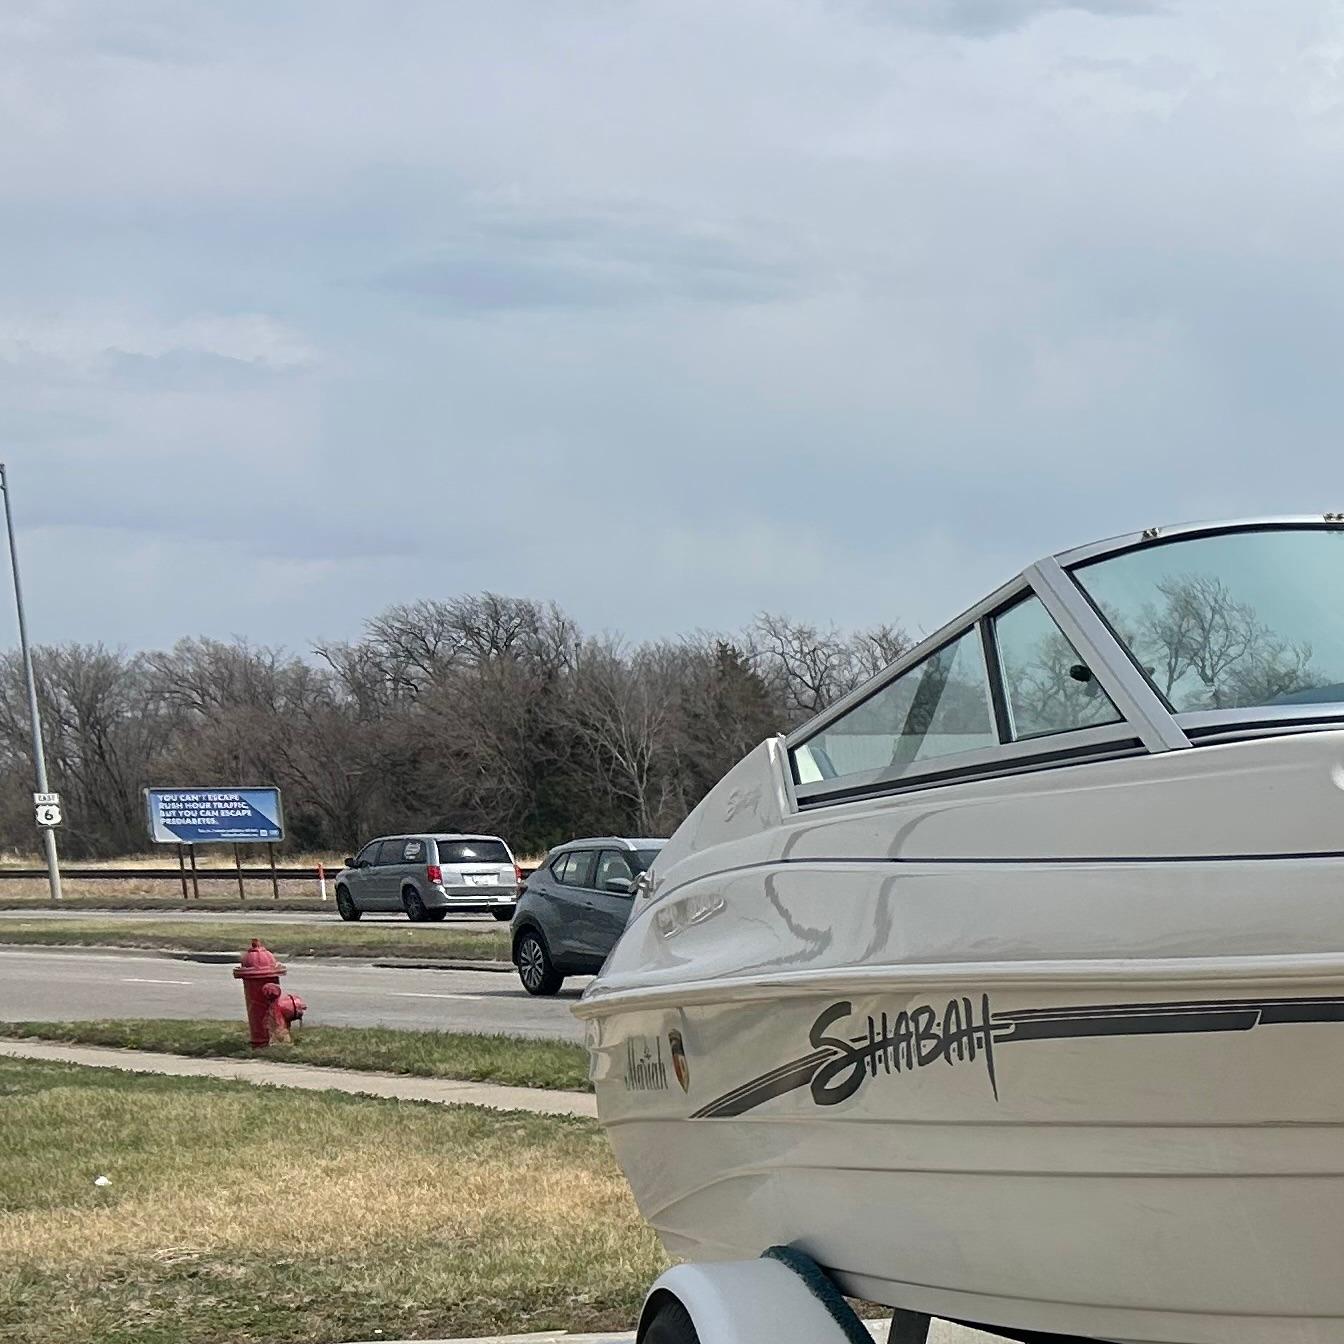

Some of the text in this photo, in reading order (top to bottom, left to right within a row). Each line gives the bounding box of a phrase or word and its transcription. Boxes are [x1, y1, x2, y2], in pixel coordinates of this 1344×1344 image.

[157, 794, 240, 802] YOU CAN'T ESCAPE
[158, 801, 184, 809] RUSH
[184, 801, 212, 809] HOUR
[45, 809, 53, 820] 6
[160, 809, 252, 817] BUT YOU CAN ESCAPE
[809, 993, 999, 1106] SHABAH
